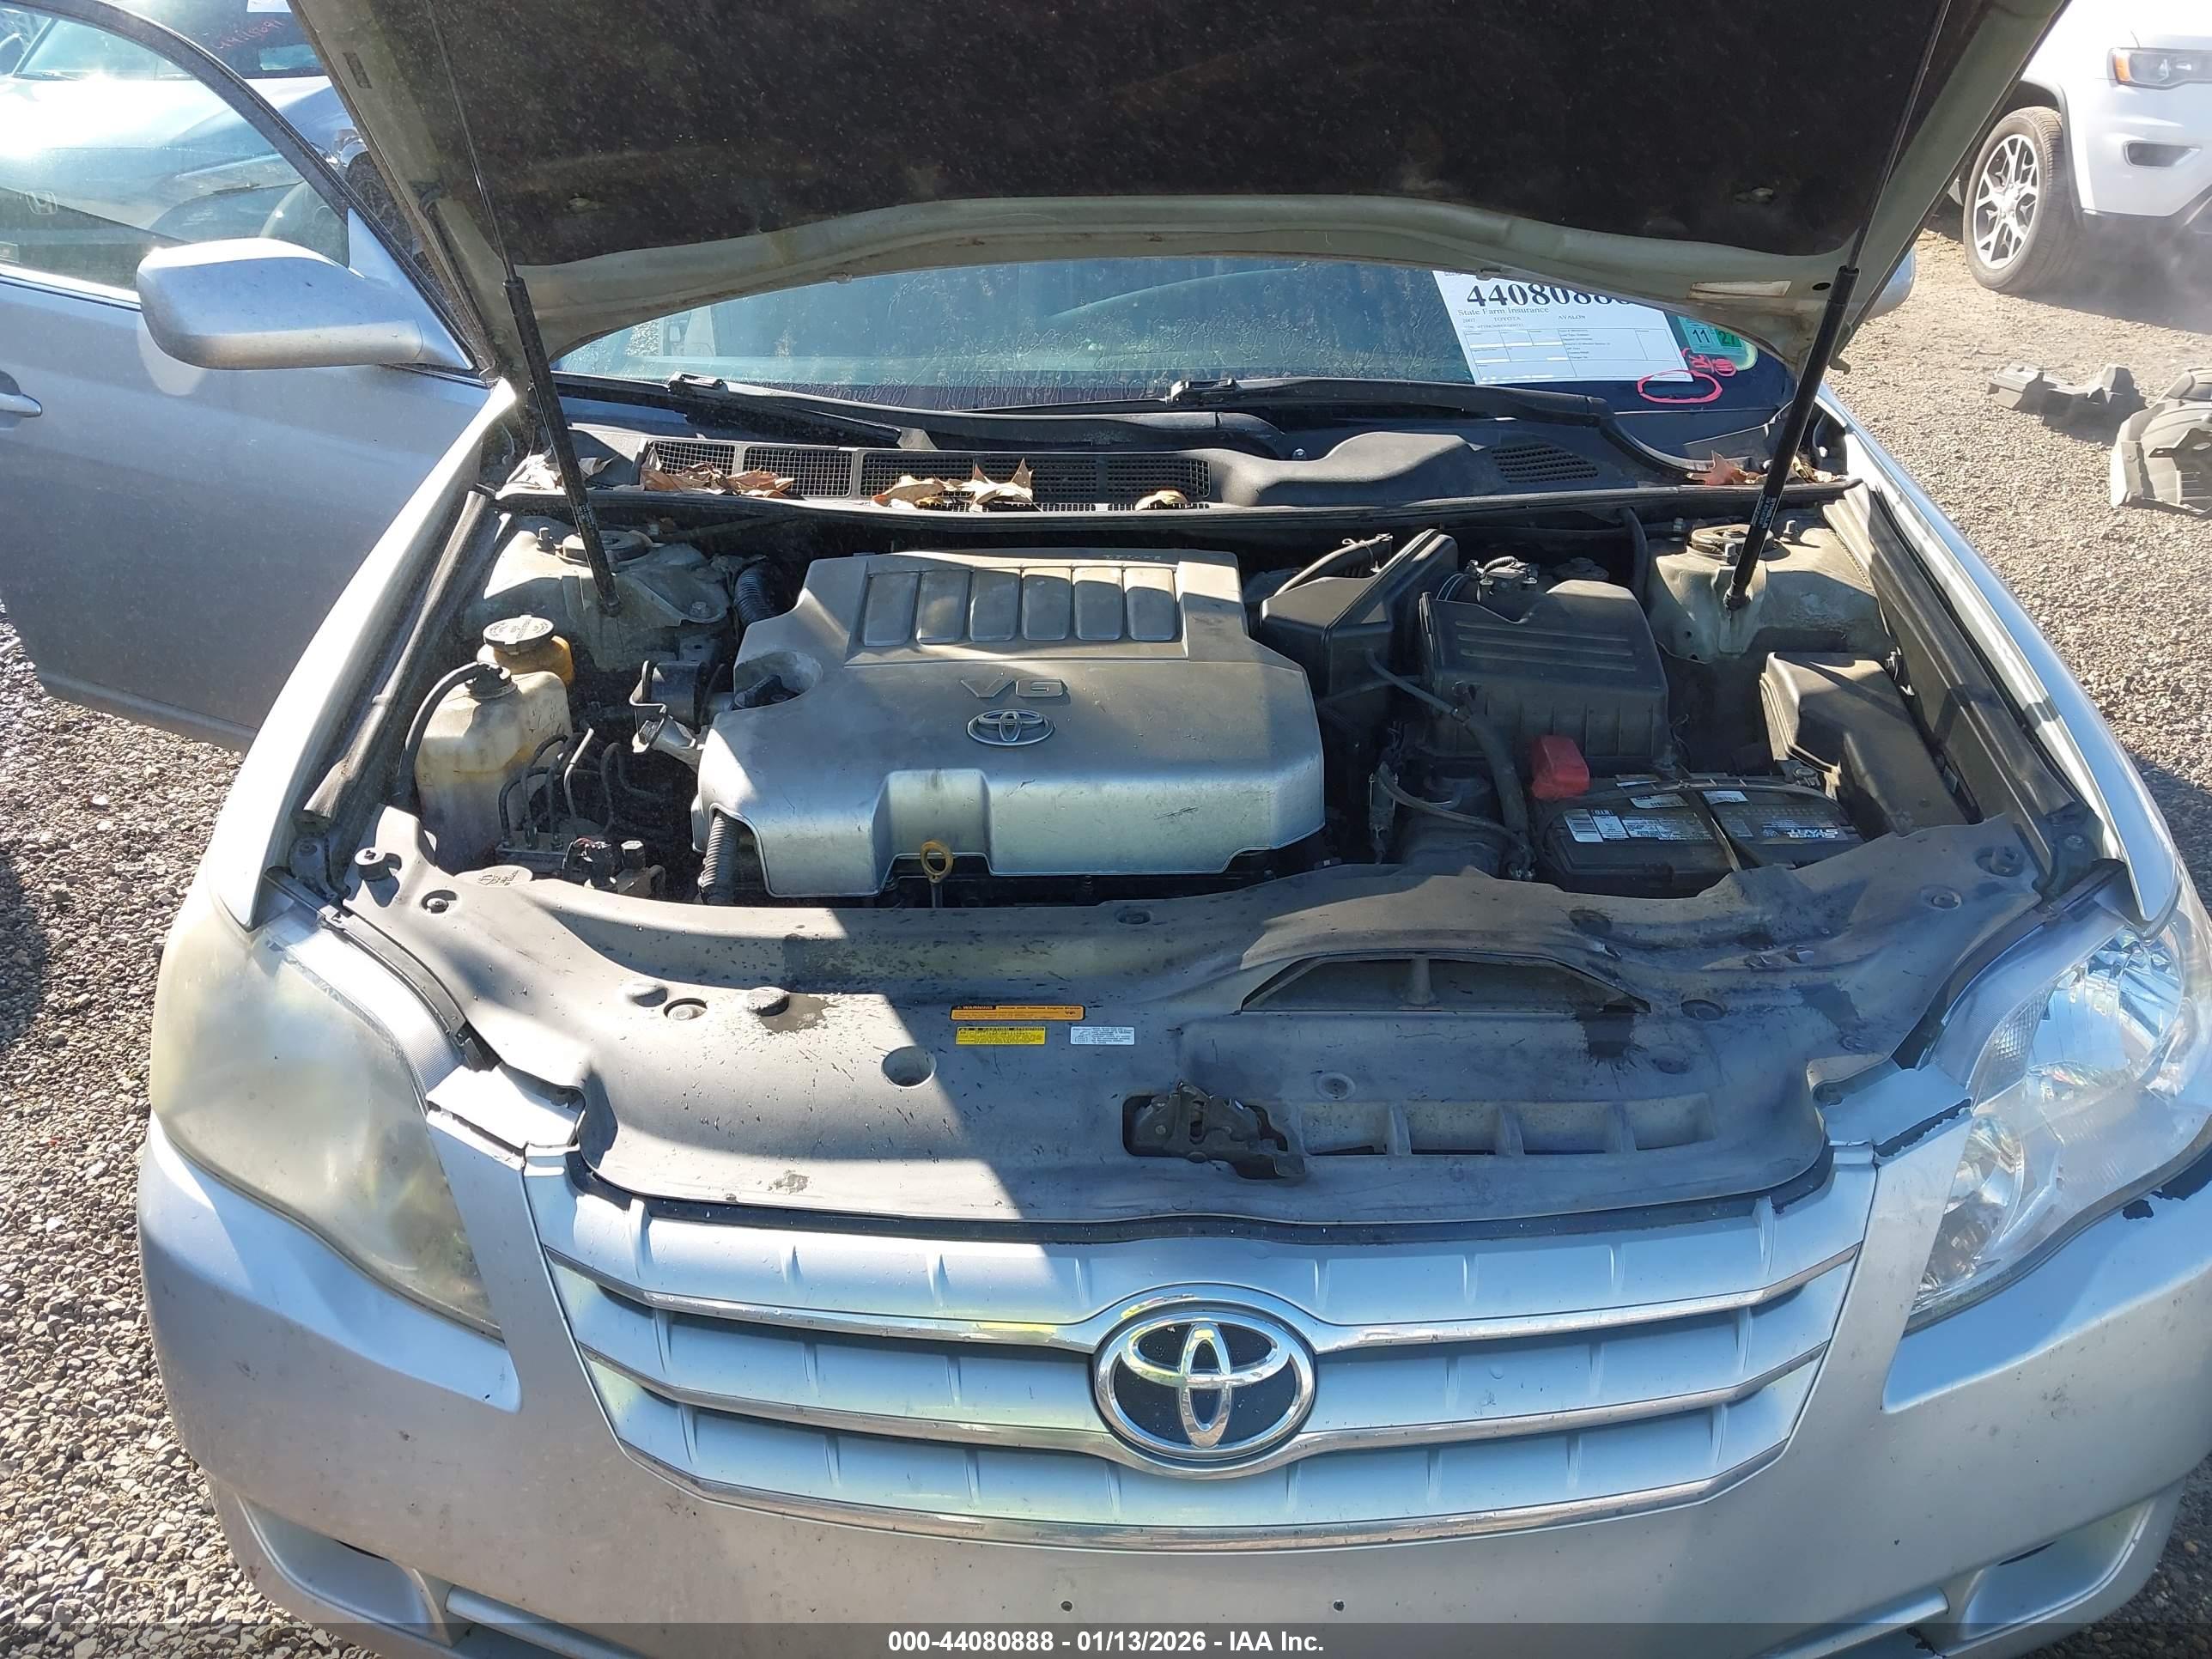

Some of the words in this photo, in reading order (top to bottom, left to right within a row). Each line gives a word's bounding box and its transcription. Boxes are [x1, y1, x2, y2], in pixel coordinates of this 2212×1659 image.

[1467, 283, 1632, 307] 4408088
[1692, 329, 1711, 343] 11
[1717, 330, 1735, 345] 27
[960, 678, 1064, 698] V6
